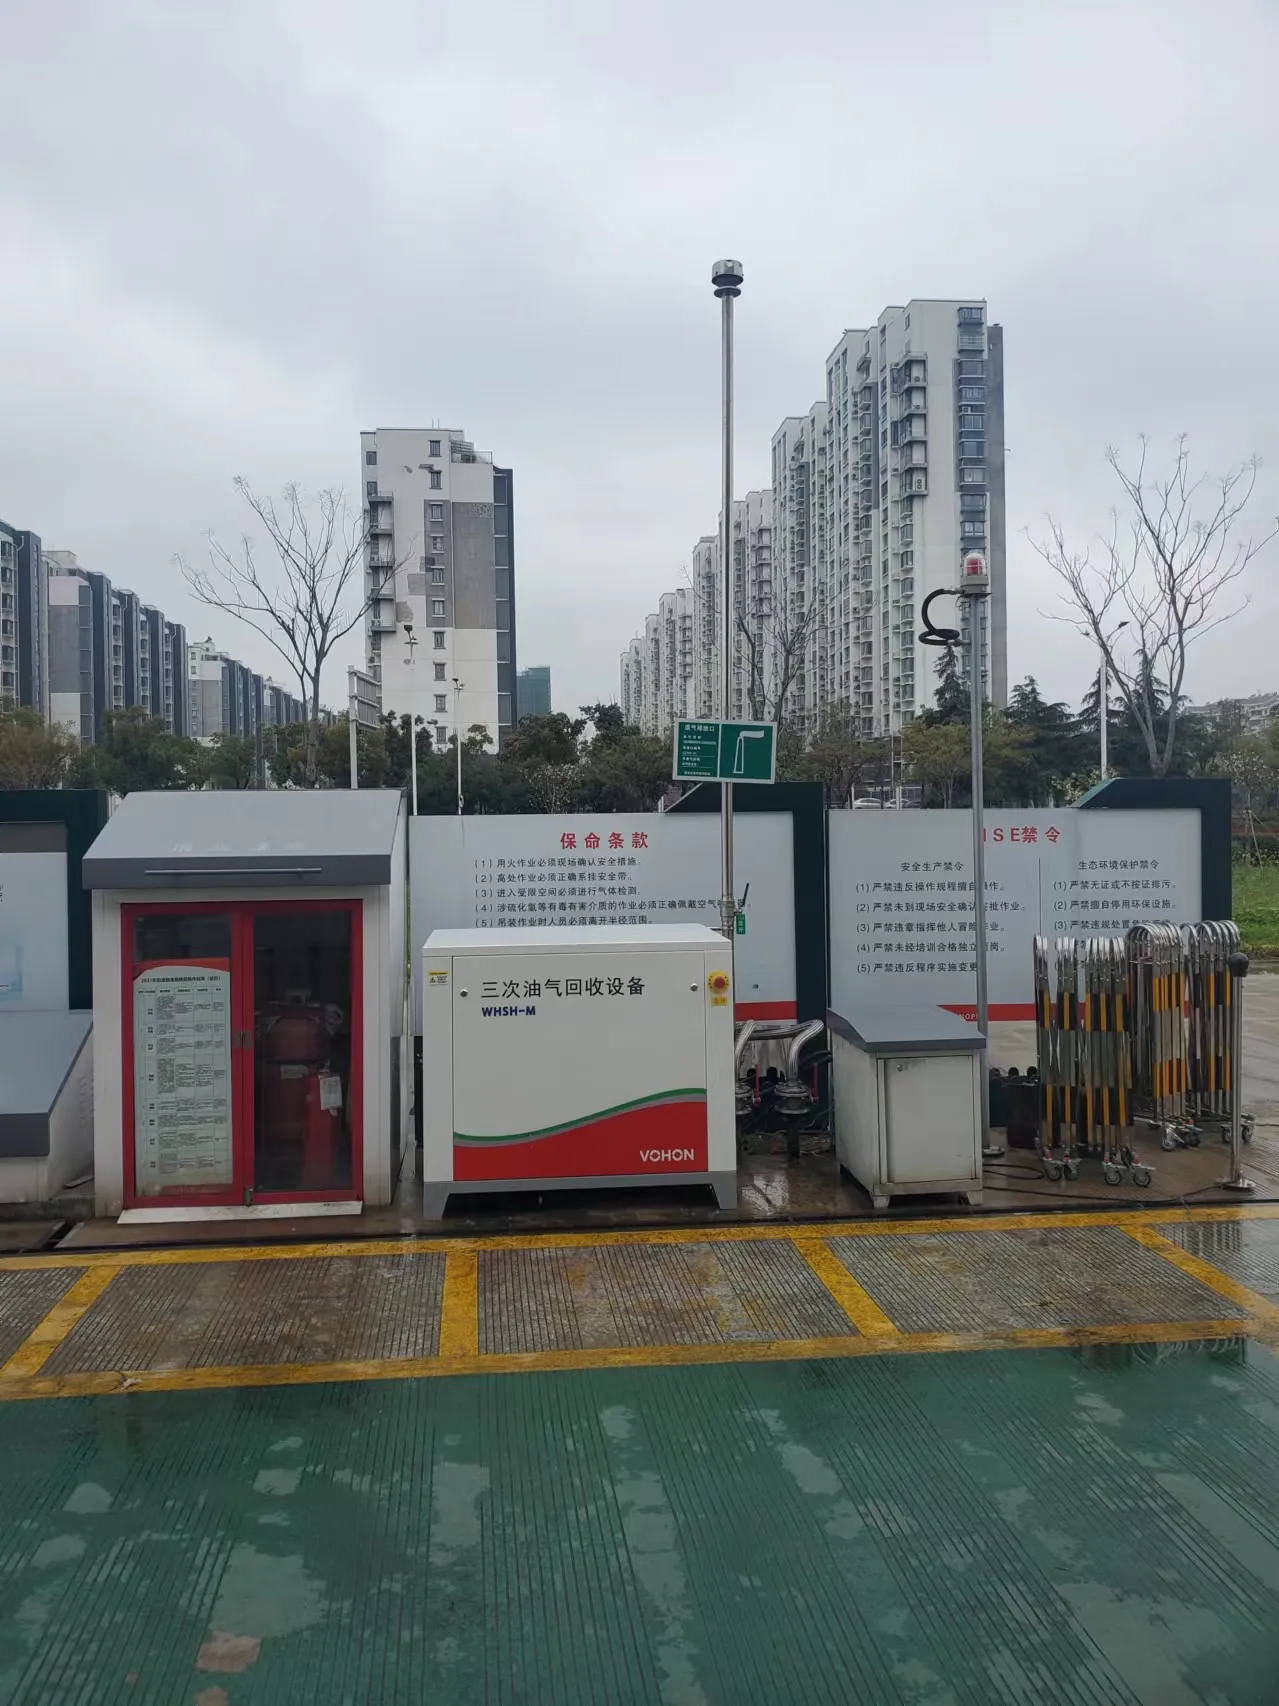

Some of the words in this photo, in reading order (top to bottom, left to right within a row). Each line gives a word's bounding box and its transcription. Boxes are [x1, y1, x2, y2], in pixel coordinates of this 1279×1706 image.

[560, 832, 648, 849] 保命条款
[983, 826, 1061, 844] SE禁令
[900, 862, 964, 872] 安全生产禁令
[1078, 860, 1160, 870] 生态环境保护禁令
[481, 976, 645, 999] 三次油气回收设备
[481, 1006, 536, 1017] WHSH-M
[640, 1149, 694, 1162] VOHON
